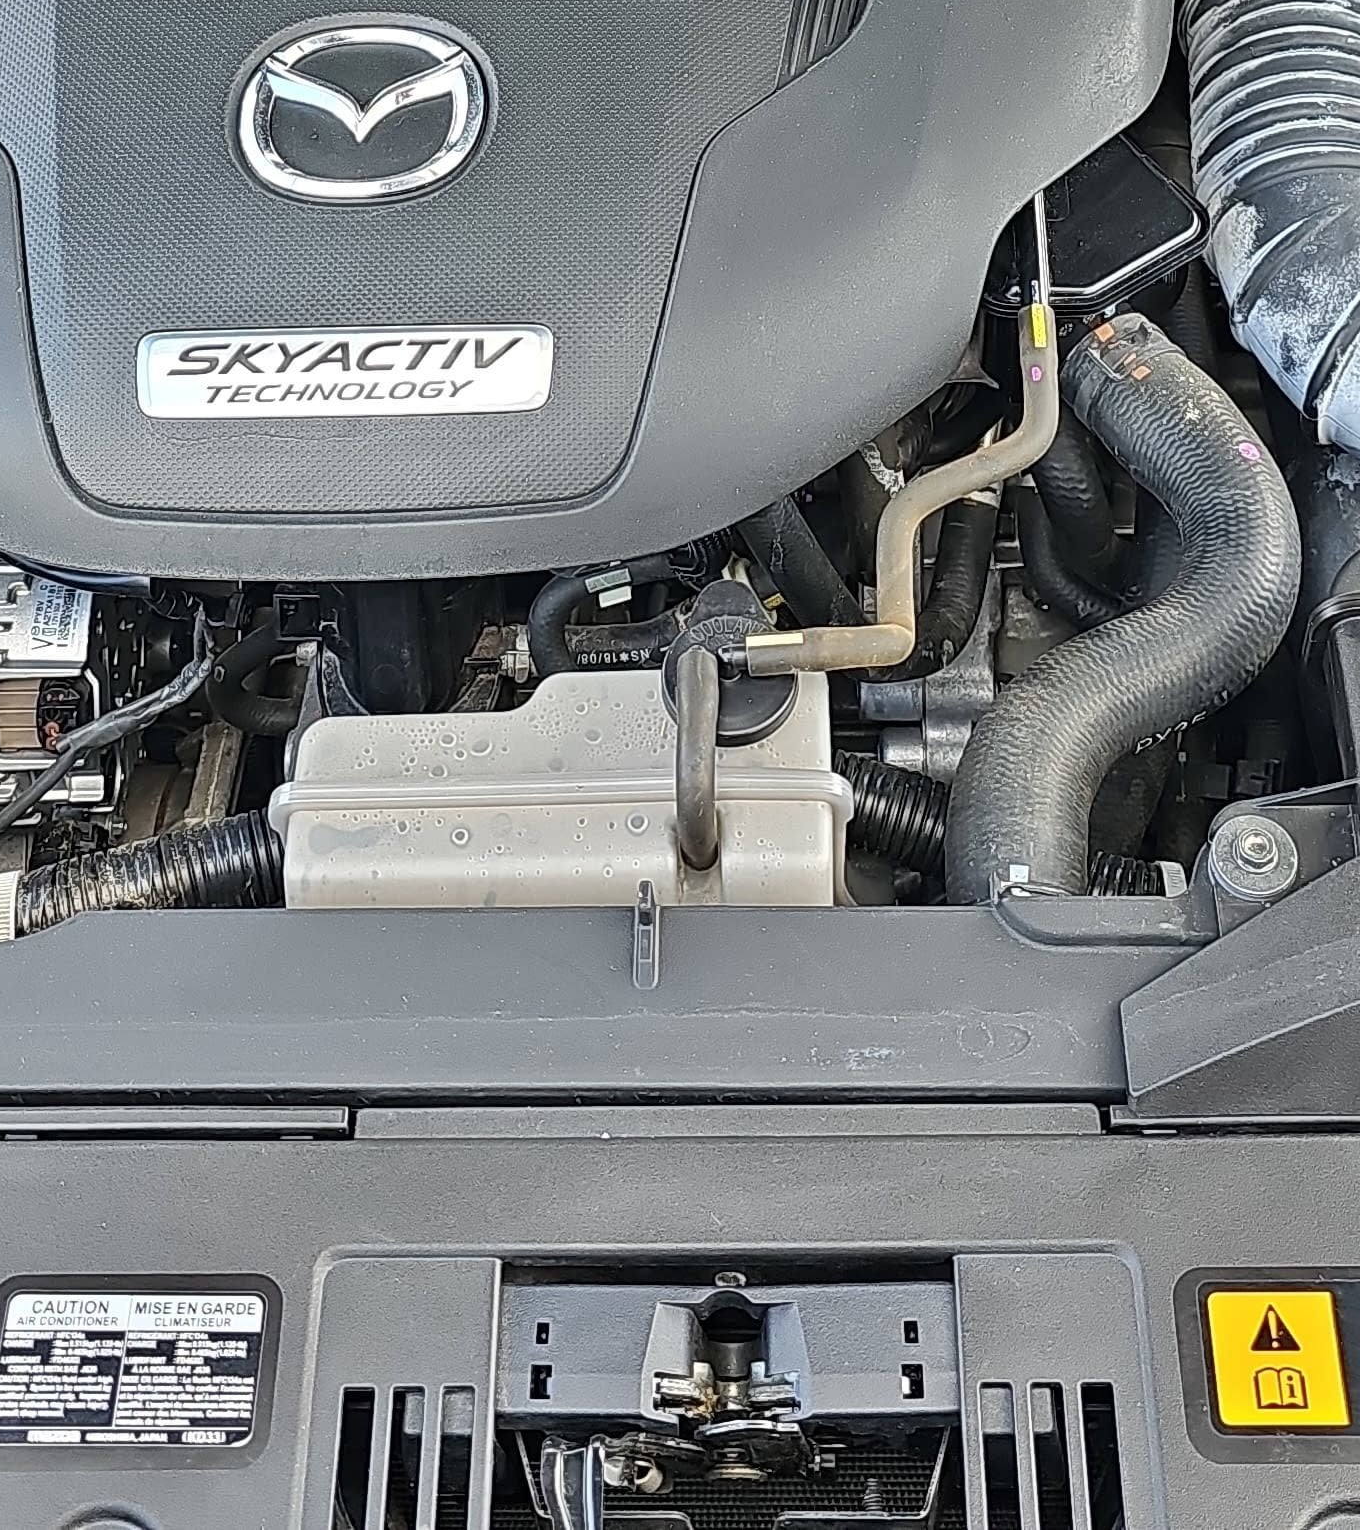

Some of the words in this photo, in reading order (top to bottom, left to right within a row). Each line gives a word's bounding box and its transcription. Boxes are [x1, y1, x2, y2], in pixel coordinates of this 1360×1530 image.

[166, 336, 524, 376] SKYACTIV
[205, 379, 475, 404] TECHNOLOGY
[31, 1300, 109, 1314] CAUTION
[134, 1301, 174, 1315] MISE
[177, 1302, 198, 1315] EN
[200, 1302, 257, 1316] GARDE
[16, 1316, 38, 1326] AIR
[40, 1316, 119, 1327] CONDITIONER
[154, 1317, 232, 1328] CLIMATISEUR
